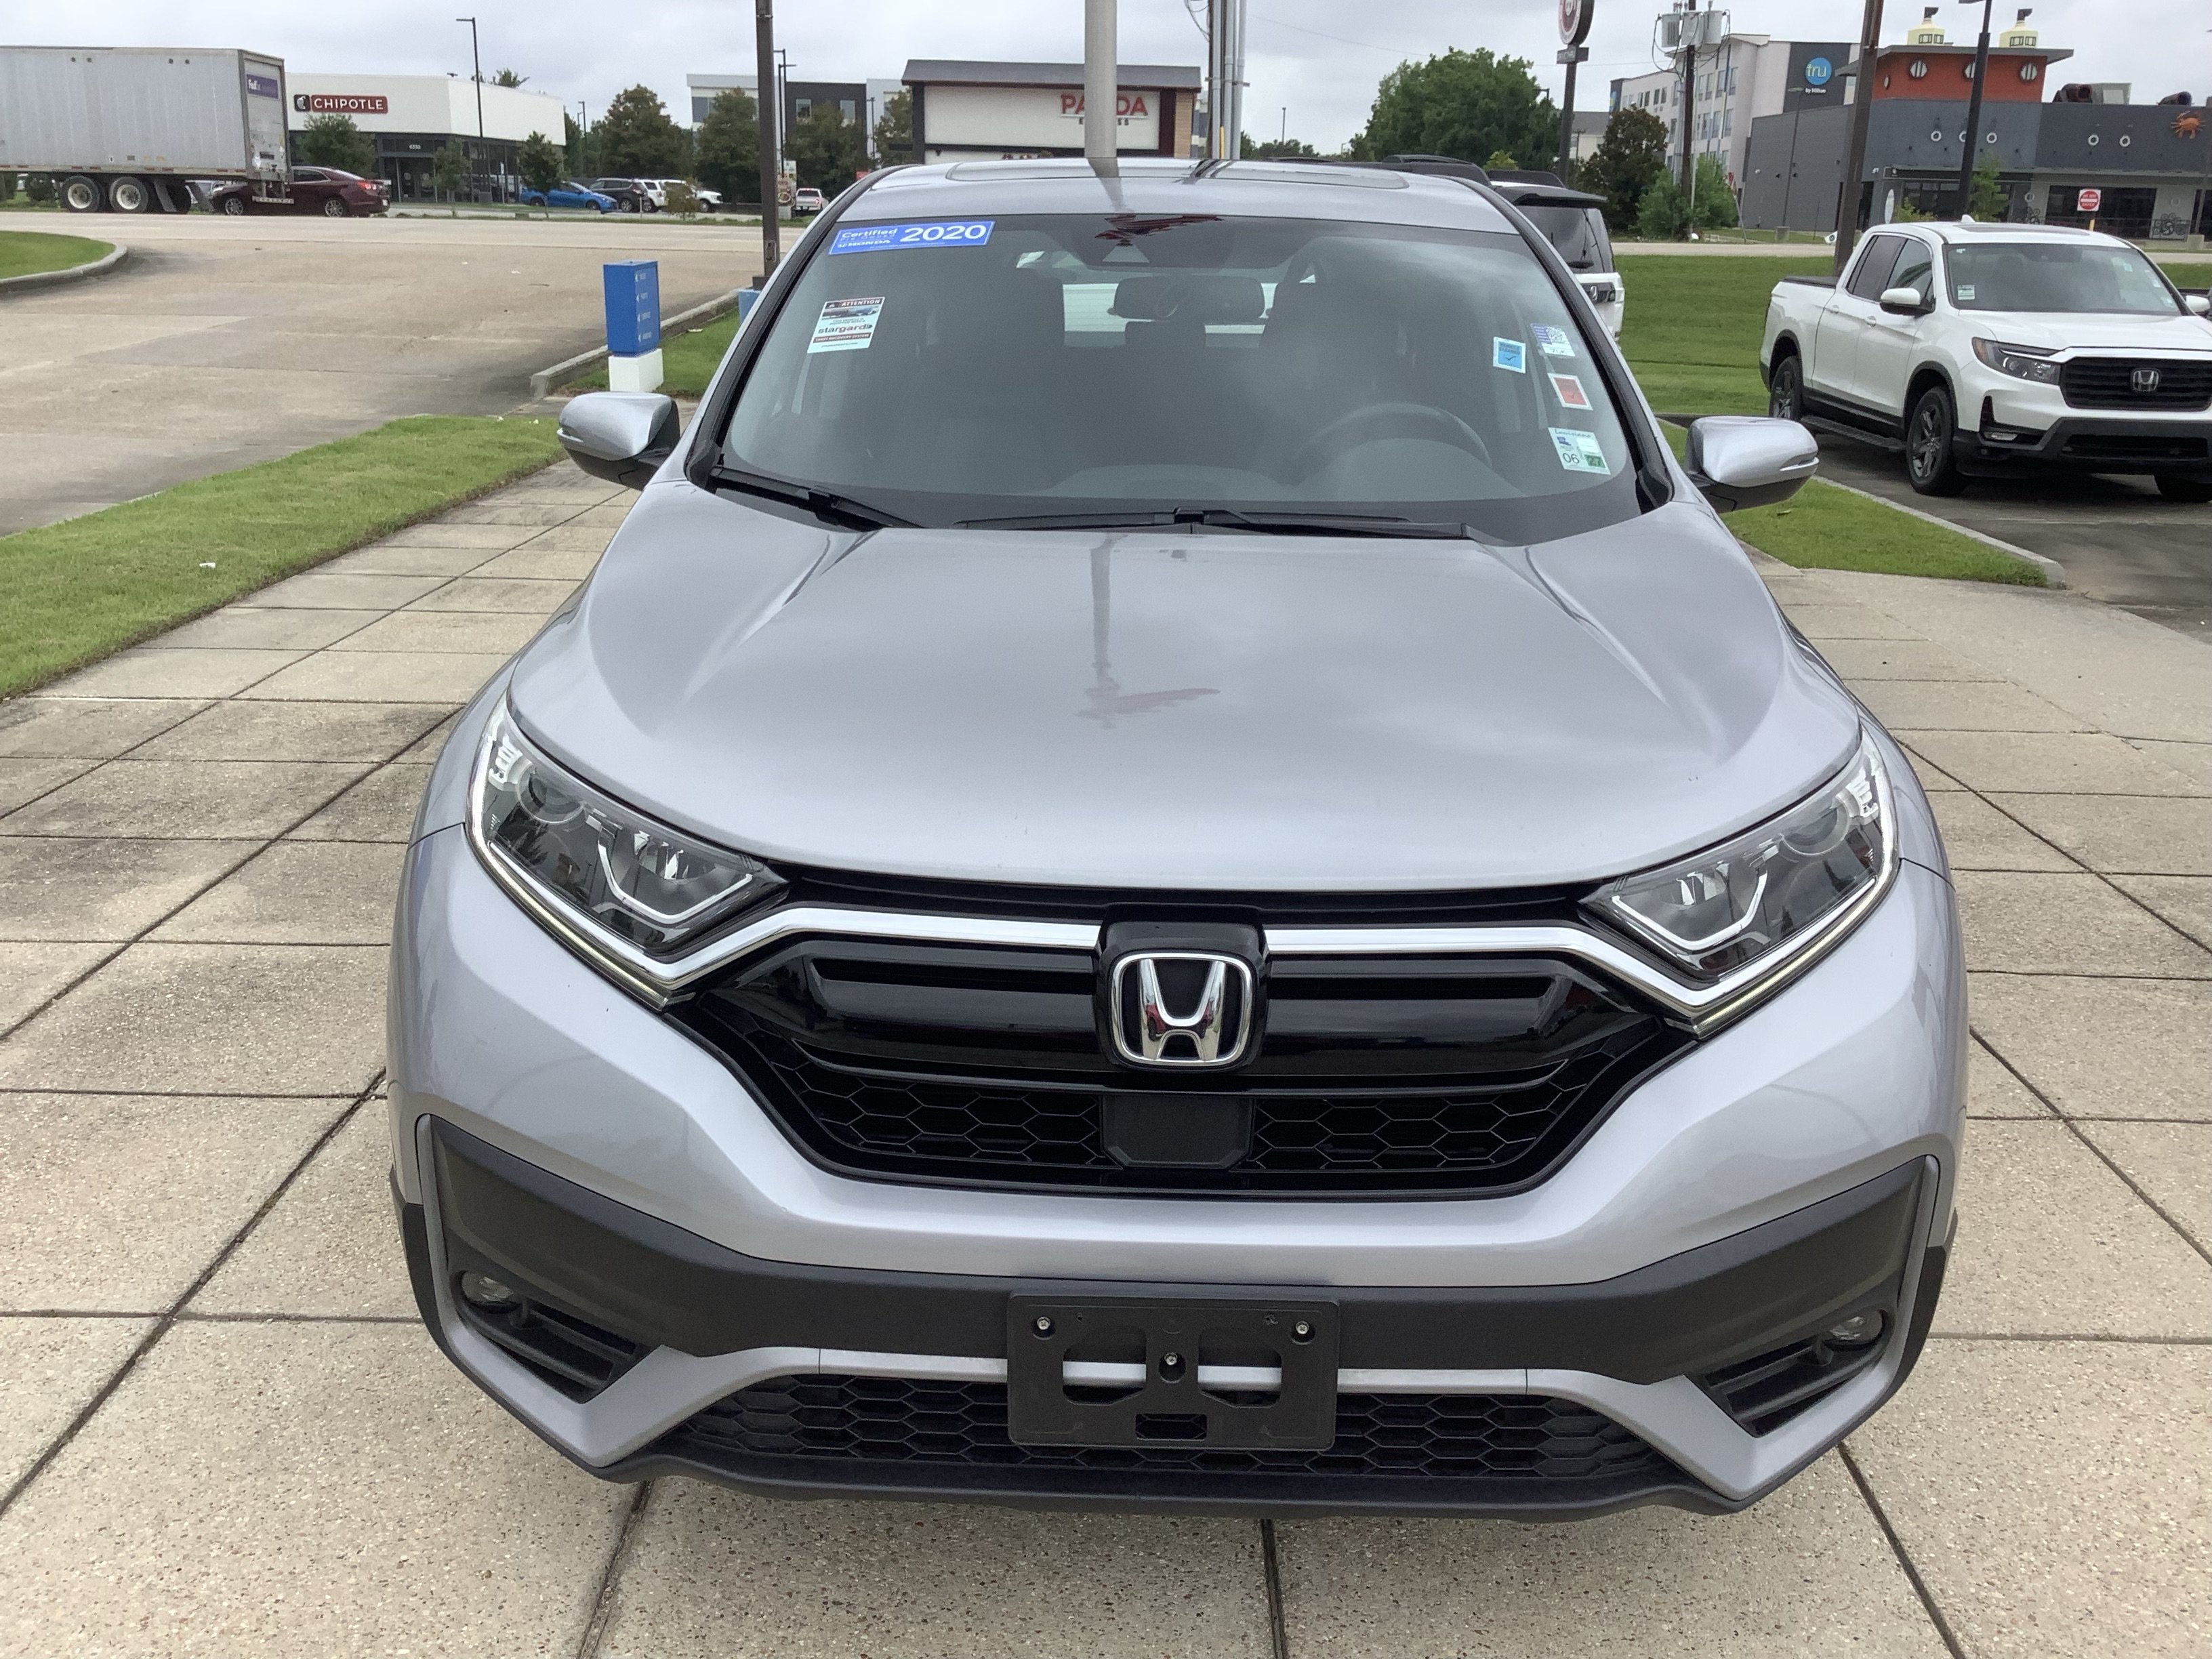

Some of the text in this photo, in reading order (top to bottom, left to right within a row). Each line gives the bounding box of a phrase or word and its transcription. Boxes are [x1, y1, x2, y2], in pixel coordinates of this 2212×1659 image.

[1807, 64, 1826, 77] tru
[314, 98, 384, 110] CHIPOTLE
[1061, 94, 1148, 116] PADA
[842, 228, 898, 239] Certified
[899, 224, 987, 243] 2020
[841, 298, 881, 307] ATTENTION
[1563, 453, 1580, 464] 06
